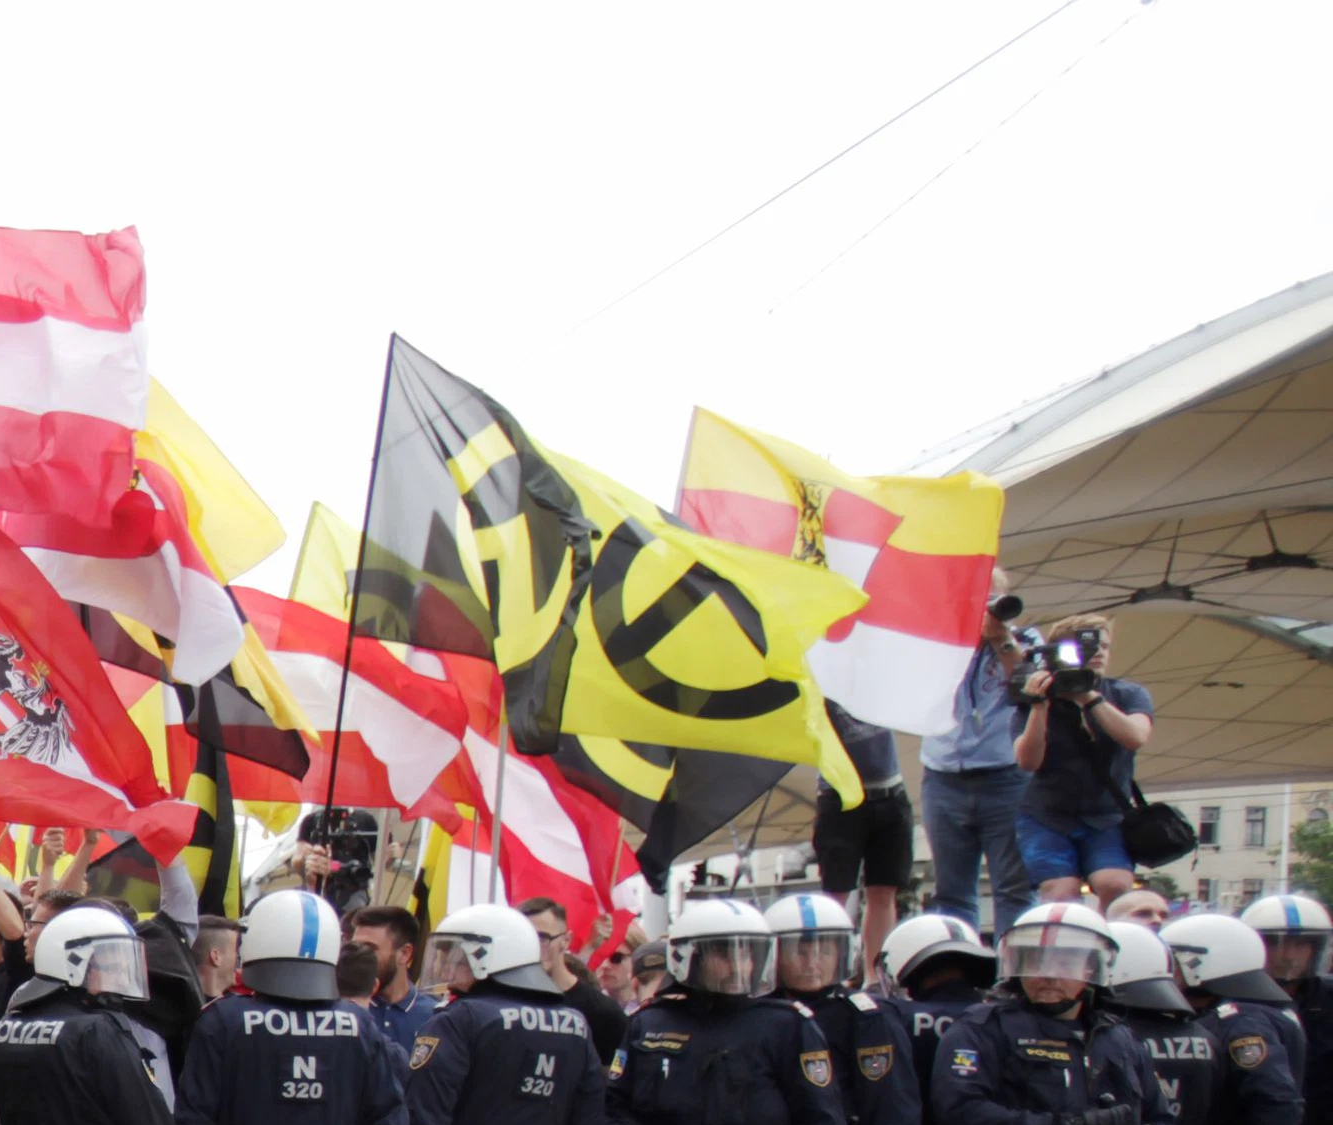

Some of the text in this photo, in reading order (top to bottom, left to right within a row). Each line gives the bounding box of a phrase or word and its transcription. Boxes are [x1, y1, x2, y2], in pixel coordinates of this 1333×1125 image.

[244, 1009, 358, 1038] POLIZEI
[499, 1006, 588, 1040] POLIZEI
[1144, 1037, 1212, 1060] LIZEI
[292, 1056, 316, 1079] N
[534, 1053, 556, 1077] N
[281, 1081, 323, 1099] 320
[520, 1077, 554, 1097] 320
